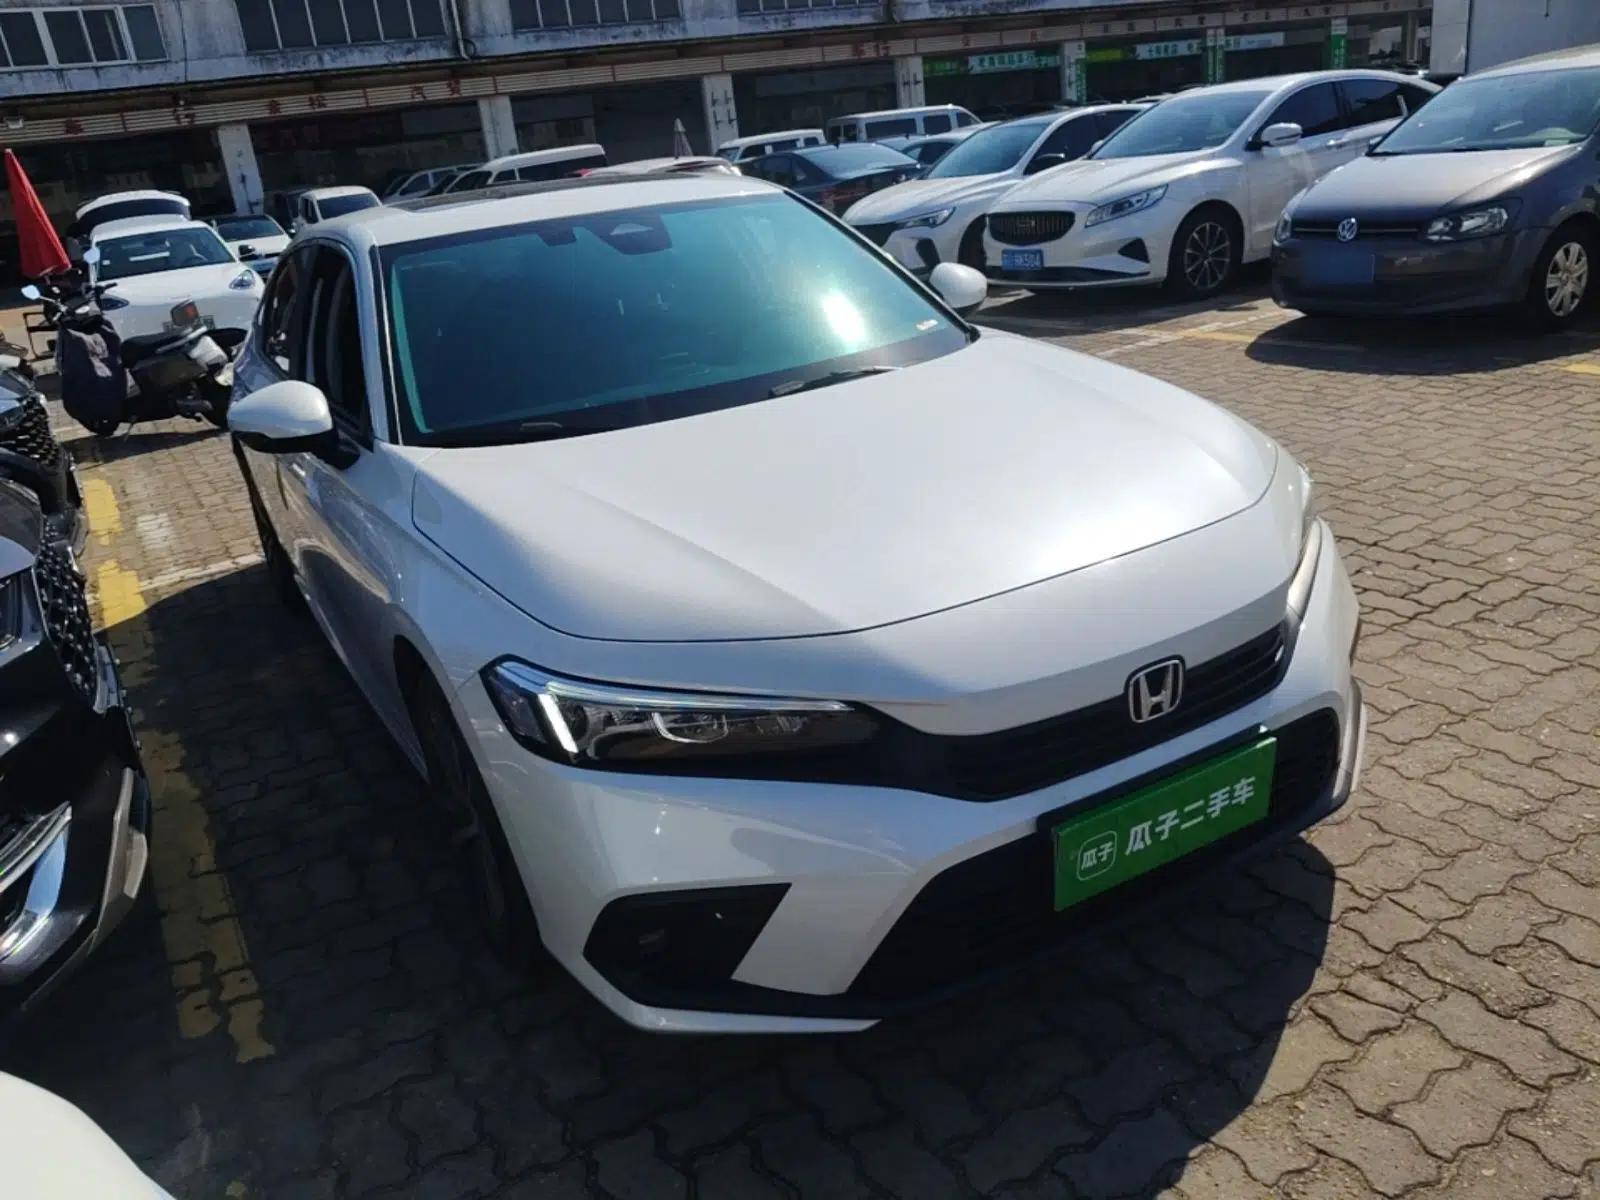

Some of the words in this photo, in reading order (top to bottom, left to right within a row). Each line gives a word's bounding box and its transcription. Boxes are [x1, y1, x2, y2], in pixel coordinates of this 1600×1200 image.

[1125, 776, 1257, 856] 瓜子二手车
[1080, 842, 1115, 869] 瓜子
